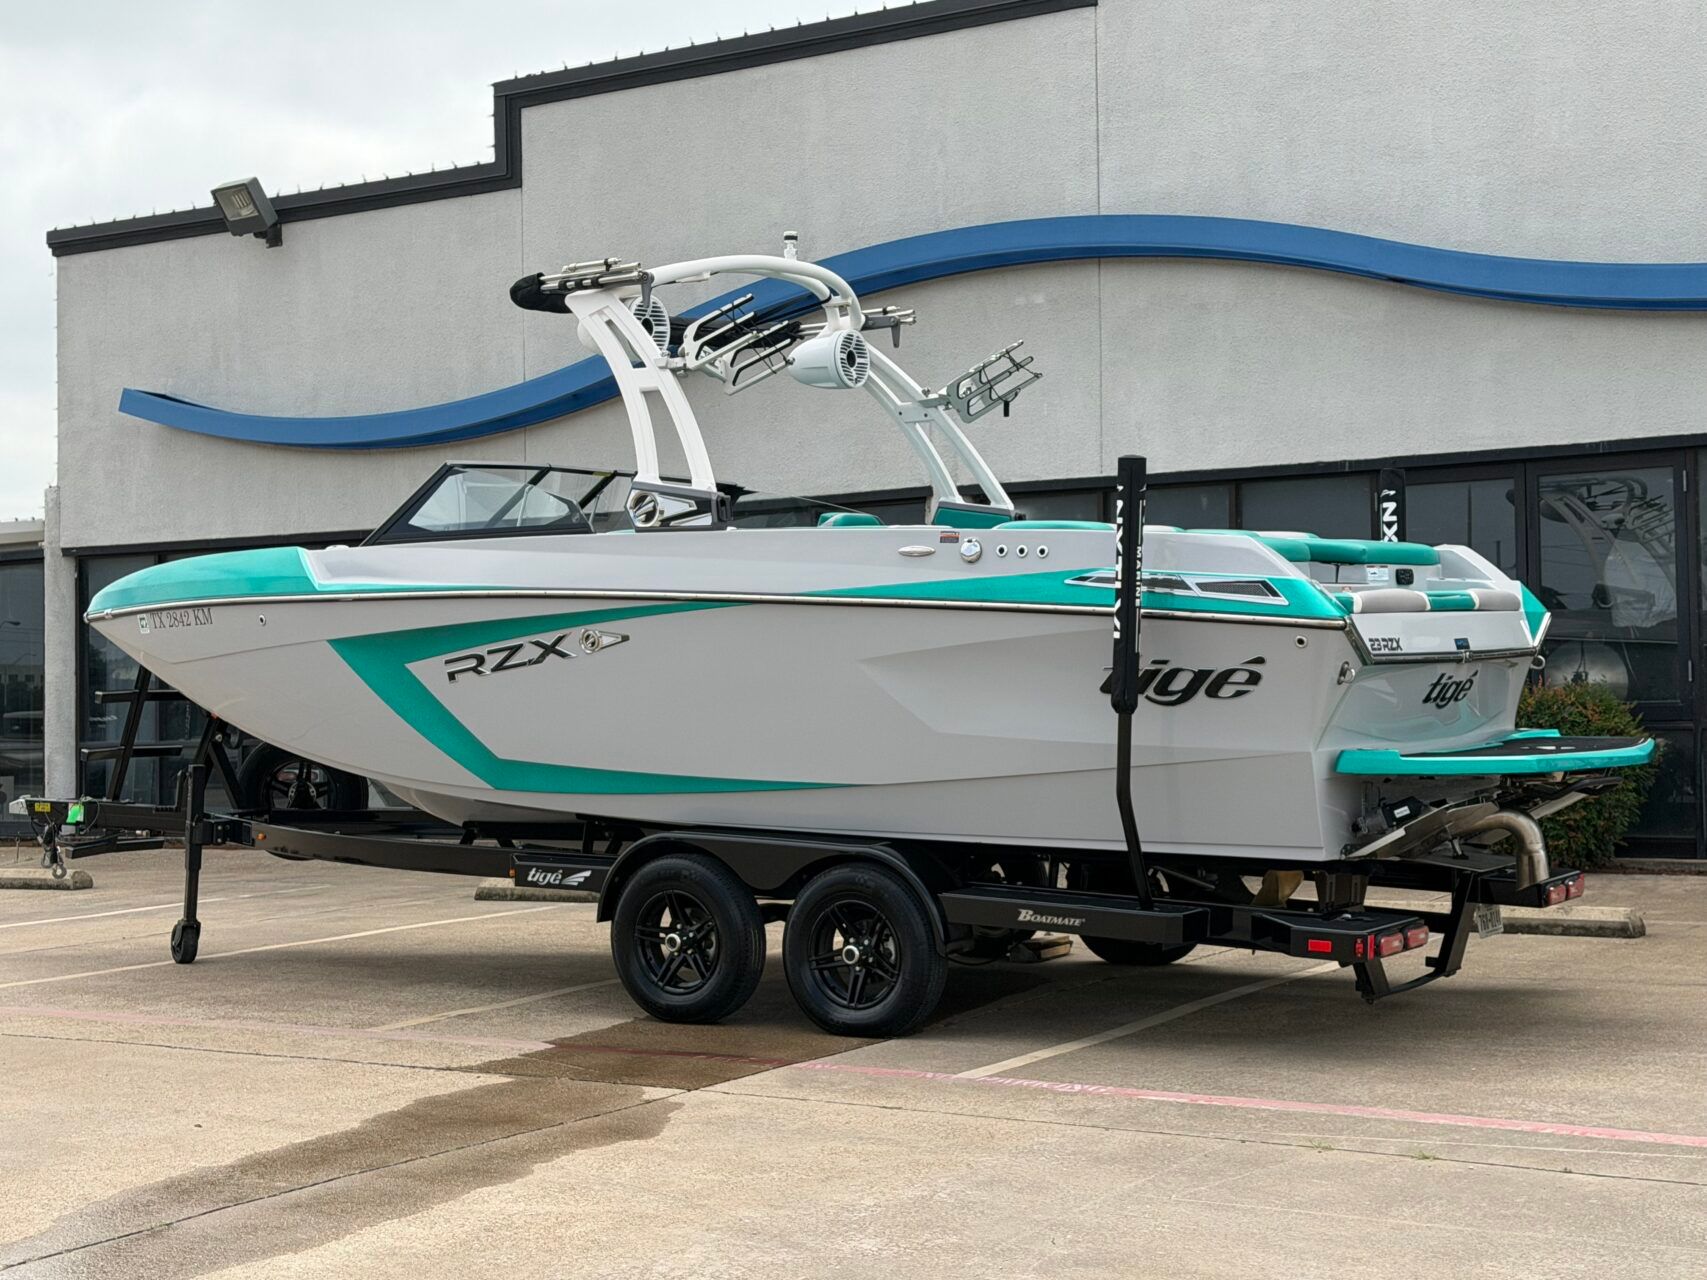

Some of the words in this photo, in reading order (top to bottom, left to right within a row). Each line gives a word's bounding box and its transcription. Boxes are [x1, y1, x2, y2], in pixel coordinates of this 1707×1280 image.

[1135, 546, 1143, 607] MARINE
[150, 611, 166, 629] TX
[166, 610, 192, 628] 2842
[193, 607, 213, 626] KM
[444, 631, 578, 683] RZX
[1381, 637, 1403, 651] RZX
[1422, 669, 1479, 709] tigé
[527, 867, 563, 886] tigé
